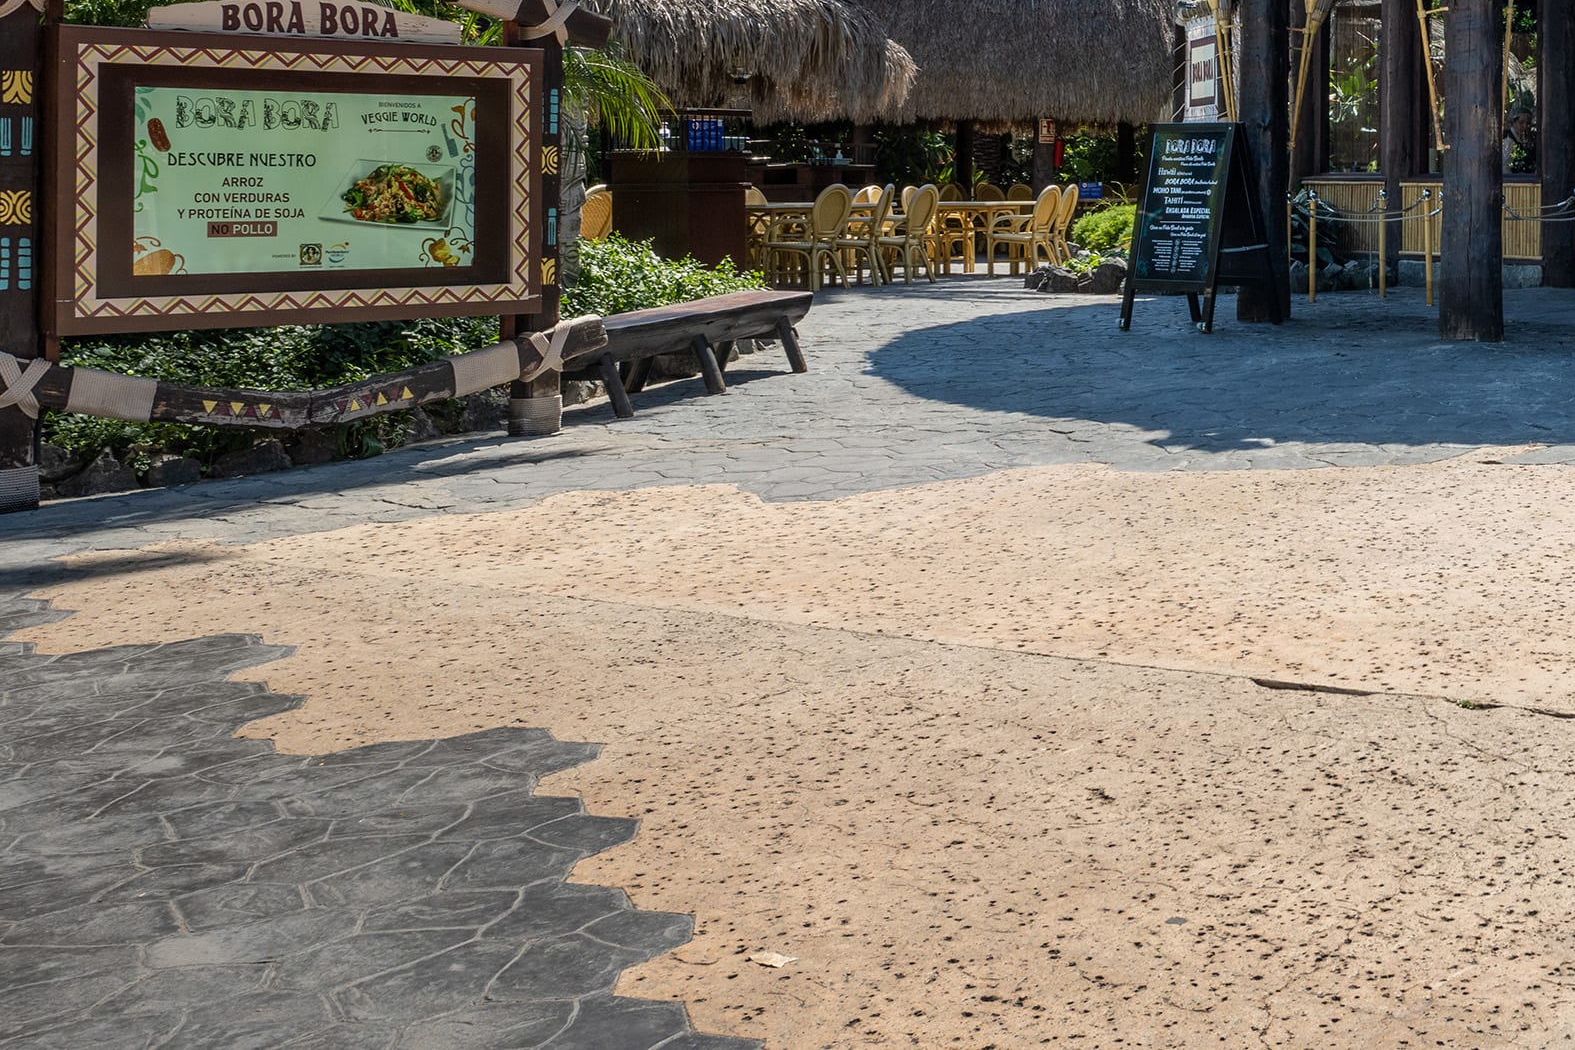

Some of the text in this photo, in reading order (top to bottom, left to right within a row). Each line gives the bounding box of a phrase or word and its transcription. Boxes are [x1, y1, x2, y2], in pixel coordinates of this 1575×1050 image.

[221, 0, 399, 38] BORA BORA
[176, 95, 339, 133] BORA BORA
[361, 111, 437, 127] VEGGIE WORLD
[167, 152, 316, 167] DESCUBRE NUESTRO
[222, 177, 264, 187] ARROZ
[194, 192, 290, 203] CON VERDURAS
[177, 206, 305, 219] Y PROTEÍNA DE SOJA
[211, 224, 273, 235] NO POLLO
